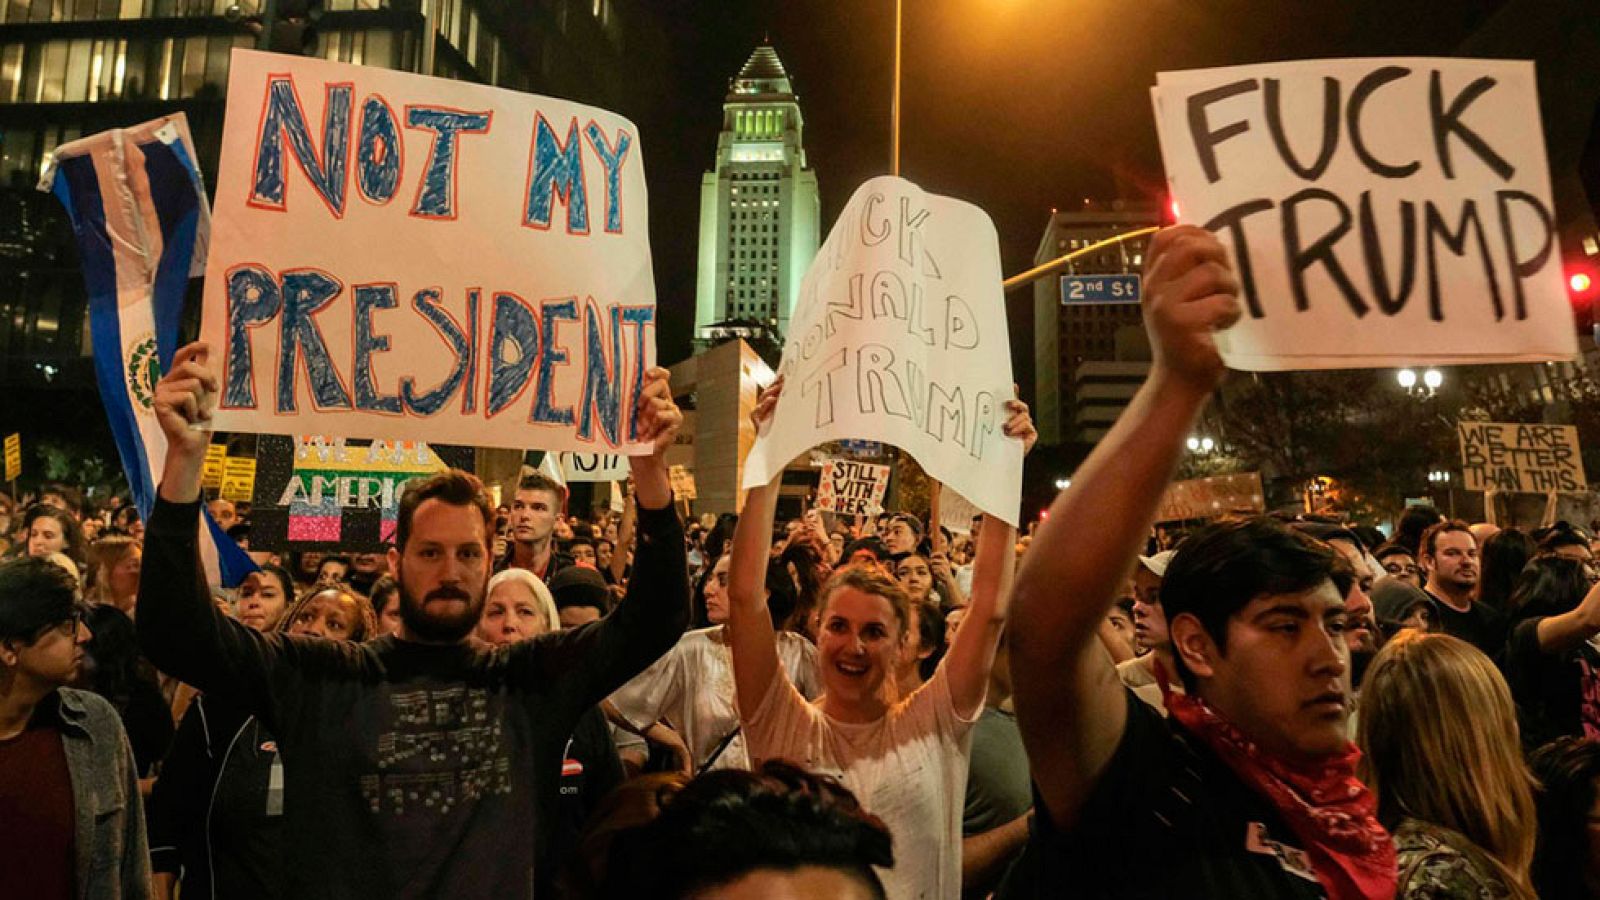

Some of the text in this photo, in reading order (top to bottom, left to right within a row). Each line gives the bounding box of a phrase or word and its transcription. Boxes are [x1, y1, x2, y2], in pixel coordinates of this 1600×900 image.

[1187, 66, 1516, 183] FUCK
[247, 73, 632, 235] NOT MY
[1201, 188, 1557, 322] TRUMP
[1070, 281, 1134, 299] 2nd St
[218, 262, 656, 446] PRESIDENT
[801, 343, 995, 460] TRUMP
[1460, 424, 1565, 447] WE ARE
[1464, 443, 1577, 469] BETTER
[833, 461, 877, 482] STILL
[1464, 465, 1521, 490] THAN
[833, 479, 874, 498] WITH
[836, 497, 867, 513] HER
